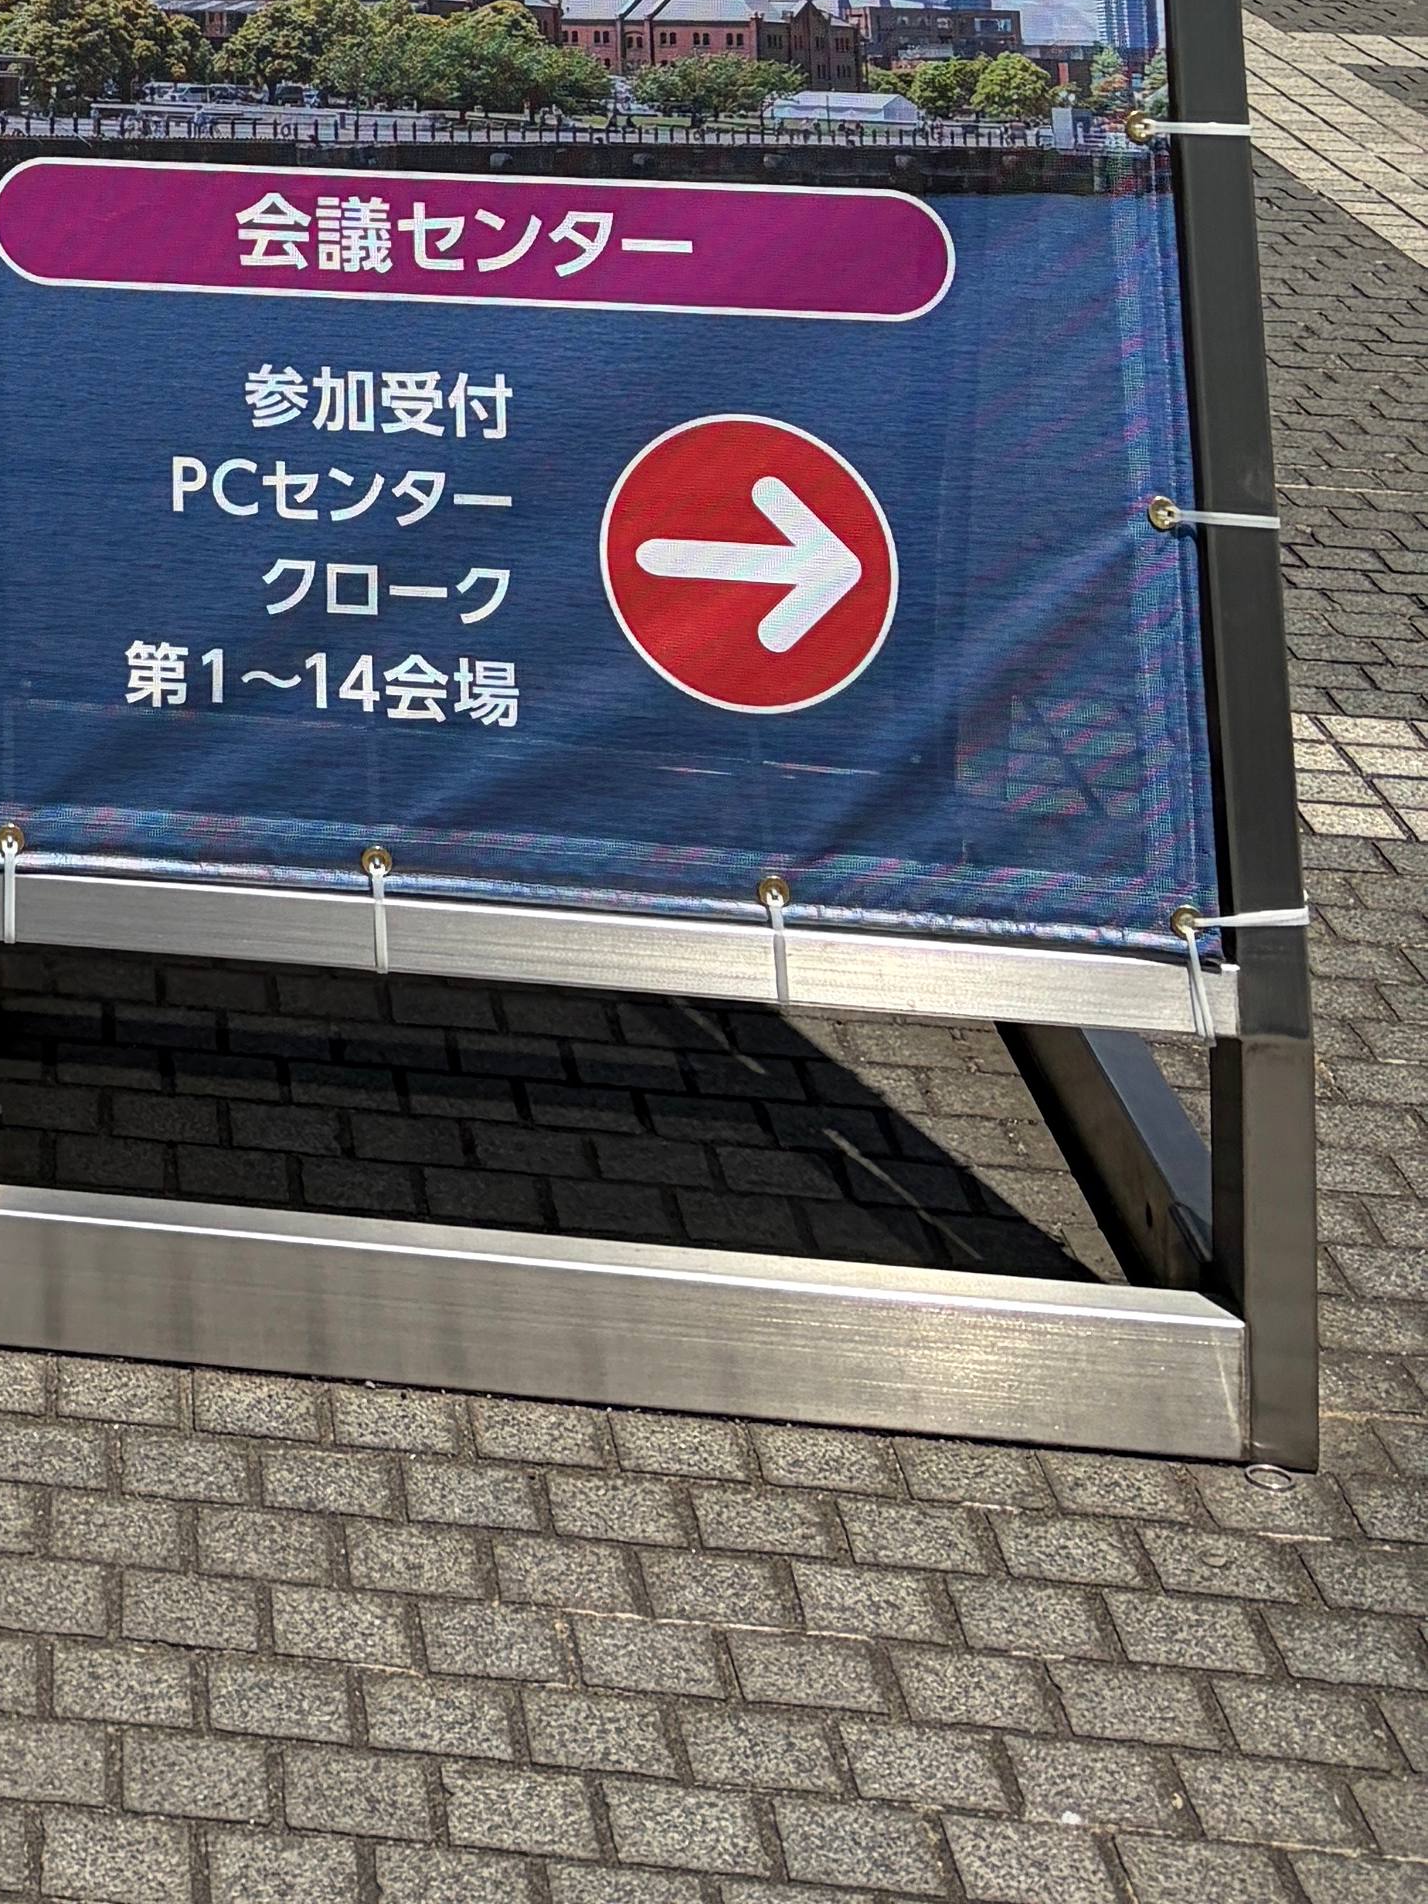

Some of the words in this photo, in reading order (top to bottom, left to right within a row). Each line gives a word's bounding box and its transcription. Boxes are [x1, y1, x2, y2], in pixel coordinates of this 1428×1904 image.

[235, 191, 692, 278] 会議センター
[244, 364, 513, 440] 参加受付
[171, 457, 512, 526] PCセンター
[260, 556, 512, 625] クローク
